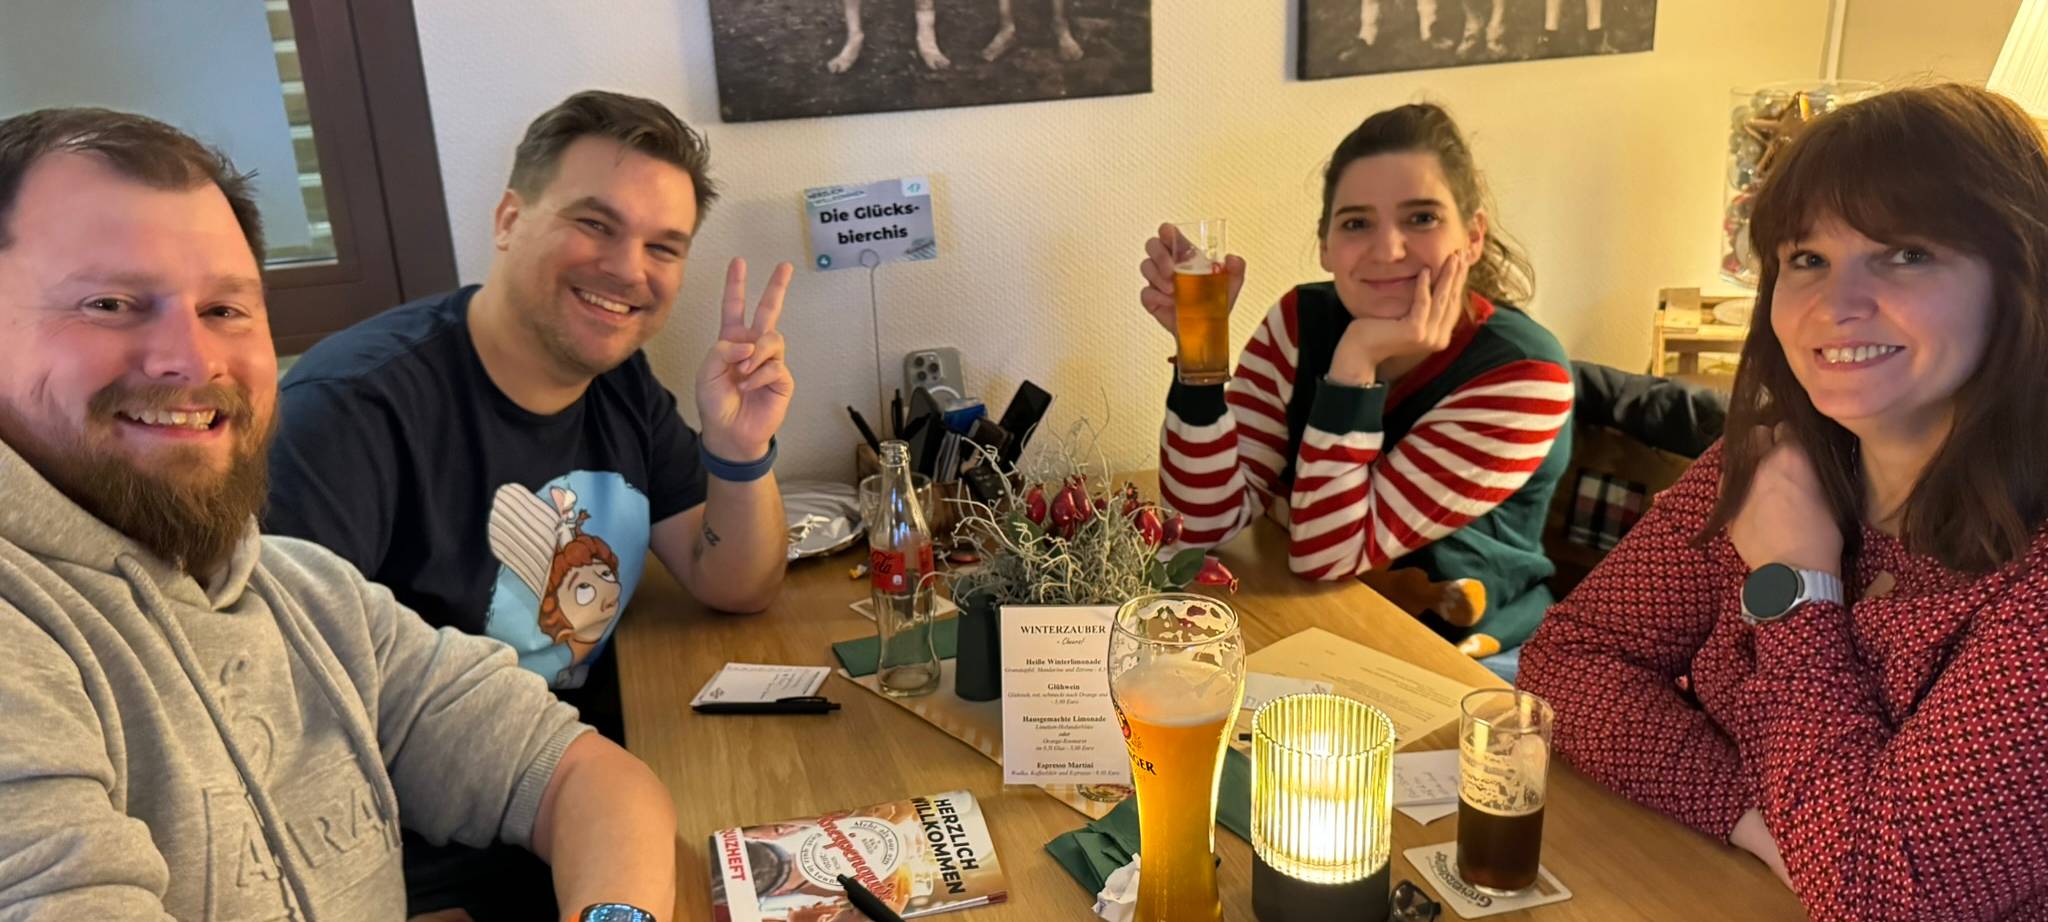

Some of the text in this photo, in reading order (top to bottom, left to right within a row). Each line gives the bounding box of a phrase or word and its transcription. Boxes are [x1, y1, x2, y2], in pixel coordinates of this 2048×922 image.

[819, 202, 920, 224] Die Glücks-
[837, 225, 908, 245] bierchis
[1020, 625, 1106, 634] WINTERZAUBER
[1037, 762, 1066, 770] Espresso
[934, 798, 979, 870] HERZLICH
[911, 797, 966, 894] WILLKOMMEN
